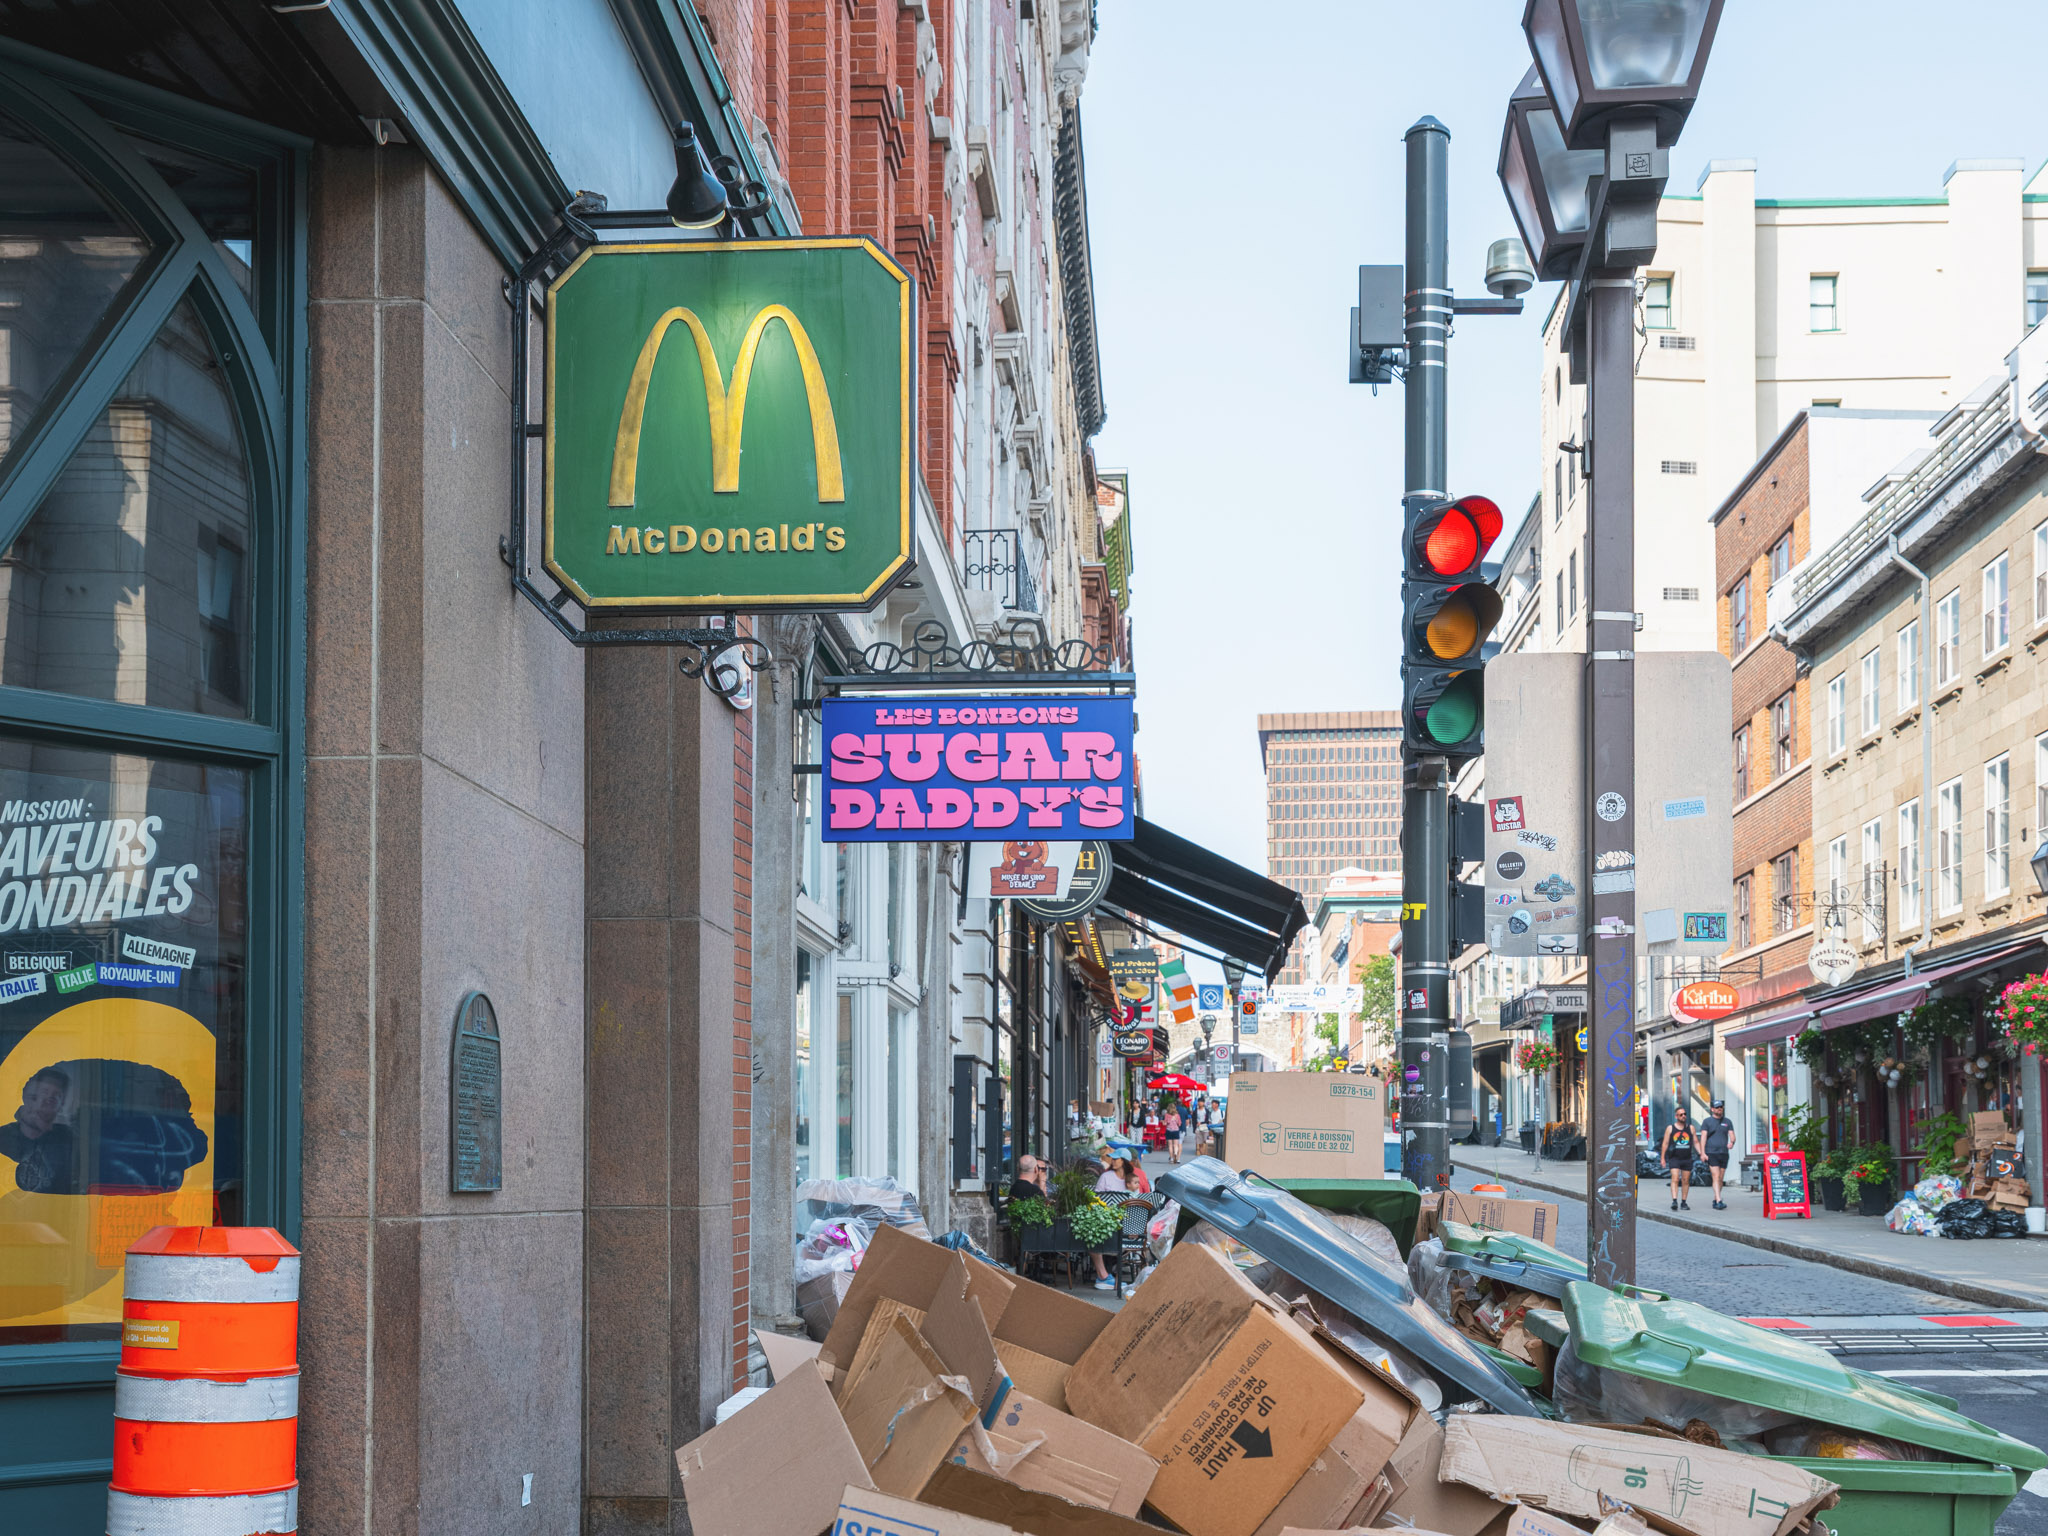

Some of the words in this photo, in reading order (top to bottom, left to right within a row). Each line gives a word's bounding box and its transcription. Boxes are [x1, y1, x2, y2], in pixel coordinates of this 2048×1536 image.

[605, 523, 847, 554] McDonald's
[875, 708, 932, 726] LES
[938, 706, 1079, 725] BONBONS
[830, 732, 1122, 783] SUGAR
[0, 815, 163, 877] AVEURS
[1001, 873, 1021, 881] MUSÉE
[126, 939, 191, 966] ALLEMAGNE
[9, 956, 67, 971] BELGIQUE
[1817, 959, 1850, 967] BRETON
[59, 970, 95, 990] ITALIE
[100, 966, 175, 985] ROYAUME-UNI
[1556, 996, 1584, 1007] HOTEL
[1116, 1037, 1148, 1045] LÉONARD
[1332, 1085, 1373, 1097] 03278-154
[1262, 1132, 1277, 1144] 32
[1287, 1132, 1311, 1141] VERRE
[1313, 1131, 1318, 1141] À
[1319, 1133, 1352, 1142] BOISSON
[1289, 1140, 1316, 1149] FROIDE
[1318, 1141, 1327, 1150] DE
[1329, 1141, 1338, 1150] 32
[1339, 1142, 1350, 1151] OZ
[161, 1324, 169, 1333] de
[1238, 1338, 1273, 1375] FRUITOPIA
[1217, 1374, 1242, 1401] FRAISE
[1242, 1375, 1258, 1392] NE
[1252, 1378, 1268, 1397] DO
[1208, 1399, 1221, 1411] SE
[1227, 1389, 1246, 1410] PAS
[1239, 1393, 1256, 1415] NOT
[1257, 1395, 1277, 1417] UP
[1193, 1410, 1212, 1430] 0125
[1198, 1408, 1230, 1445] OUVRIR
[1215, 1414, 1239, 1442] OPEN
[1187, 1441, 1203, 1457] ICI
[1193, 1439, 1218, 1466] HERE
[1201, 1441, 1239, 1481] HAUT
[1624, 1466, 1648, 1489] 16
